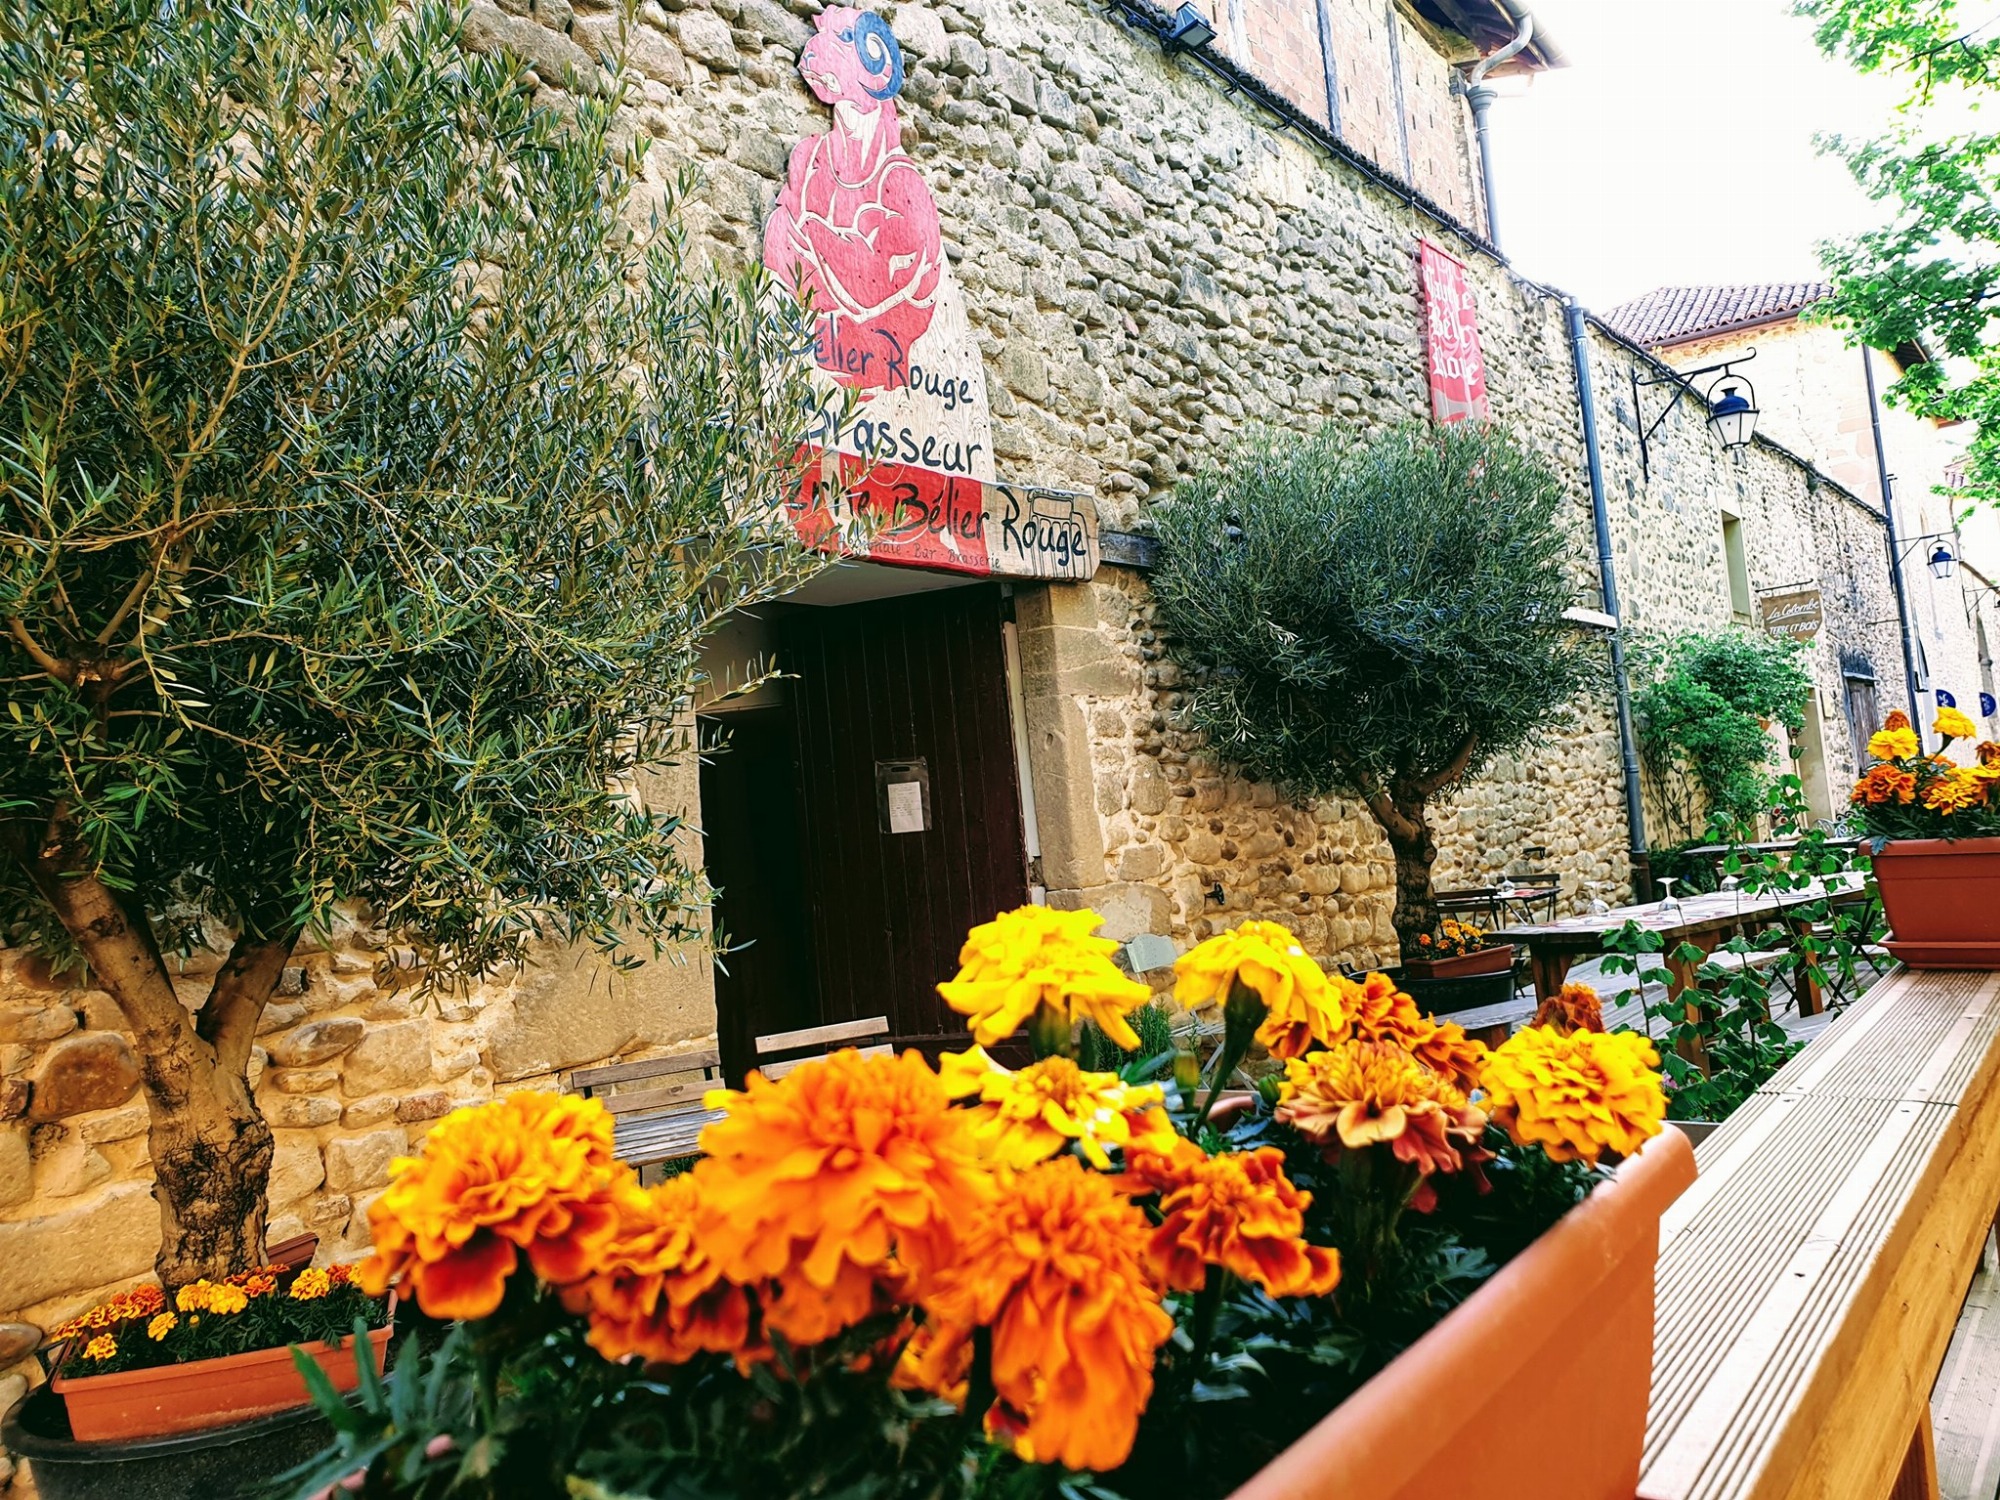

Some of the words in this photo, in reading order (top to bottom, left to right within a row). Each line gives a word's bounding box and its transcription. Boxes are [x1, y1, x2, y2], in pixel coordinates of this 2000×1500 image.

[875, 328, 973, 410] Rouge
[886, 476, 990, 539] Bélier
[1001, 486, 1087, 567] Rouge
[913, 542, 937, 559] Bar
[949, 549, 1001, 569] Brasserie
[1766, 607, 1781, 621] La
[1782, 598, 1819, 615] Colombe
